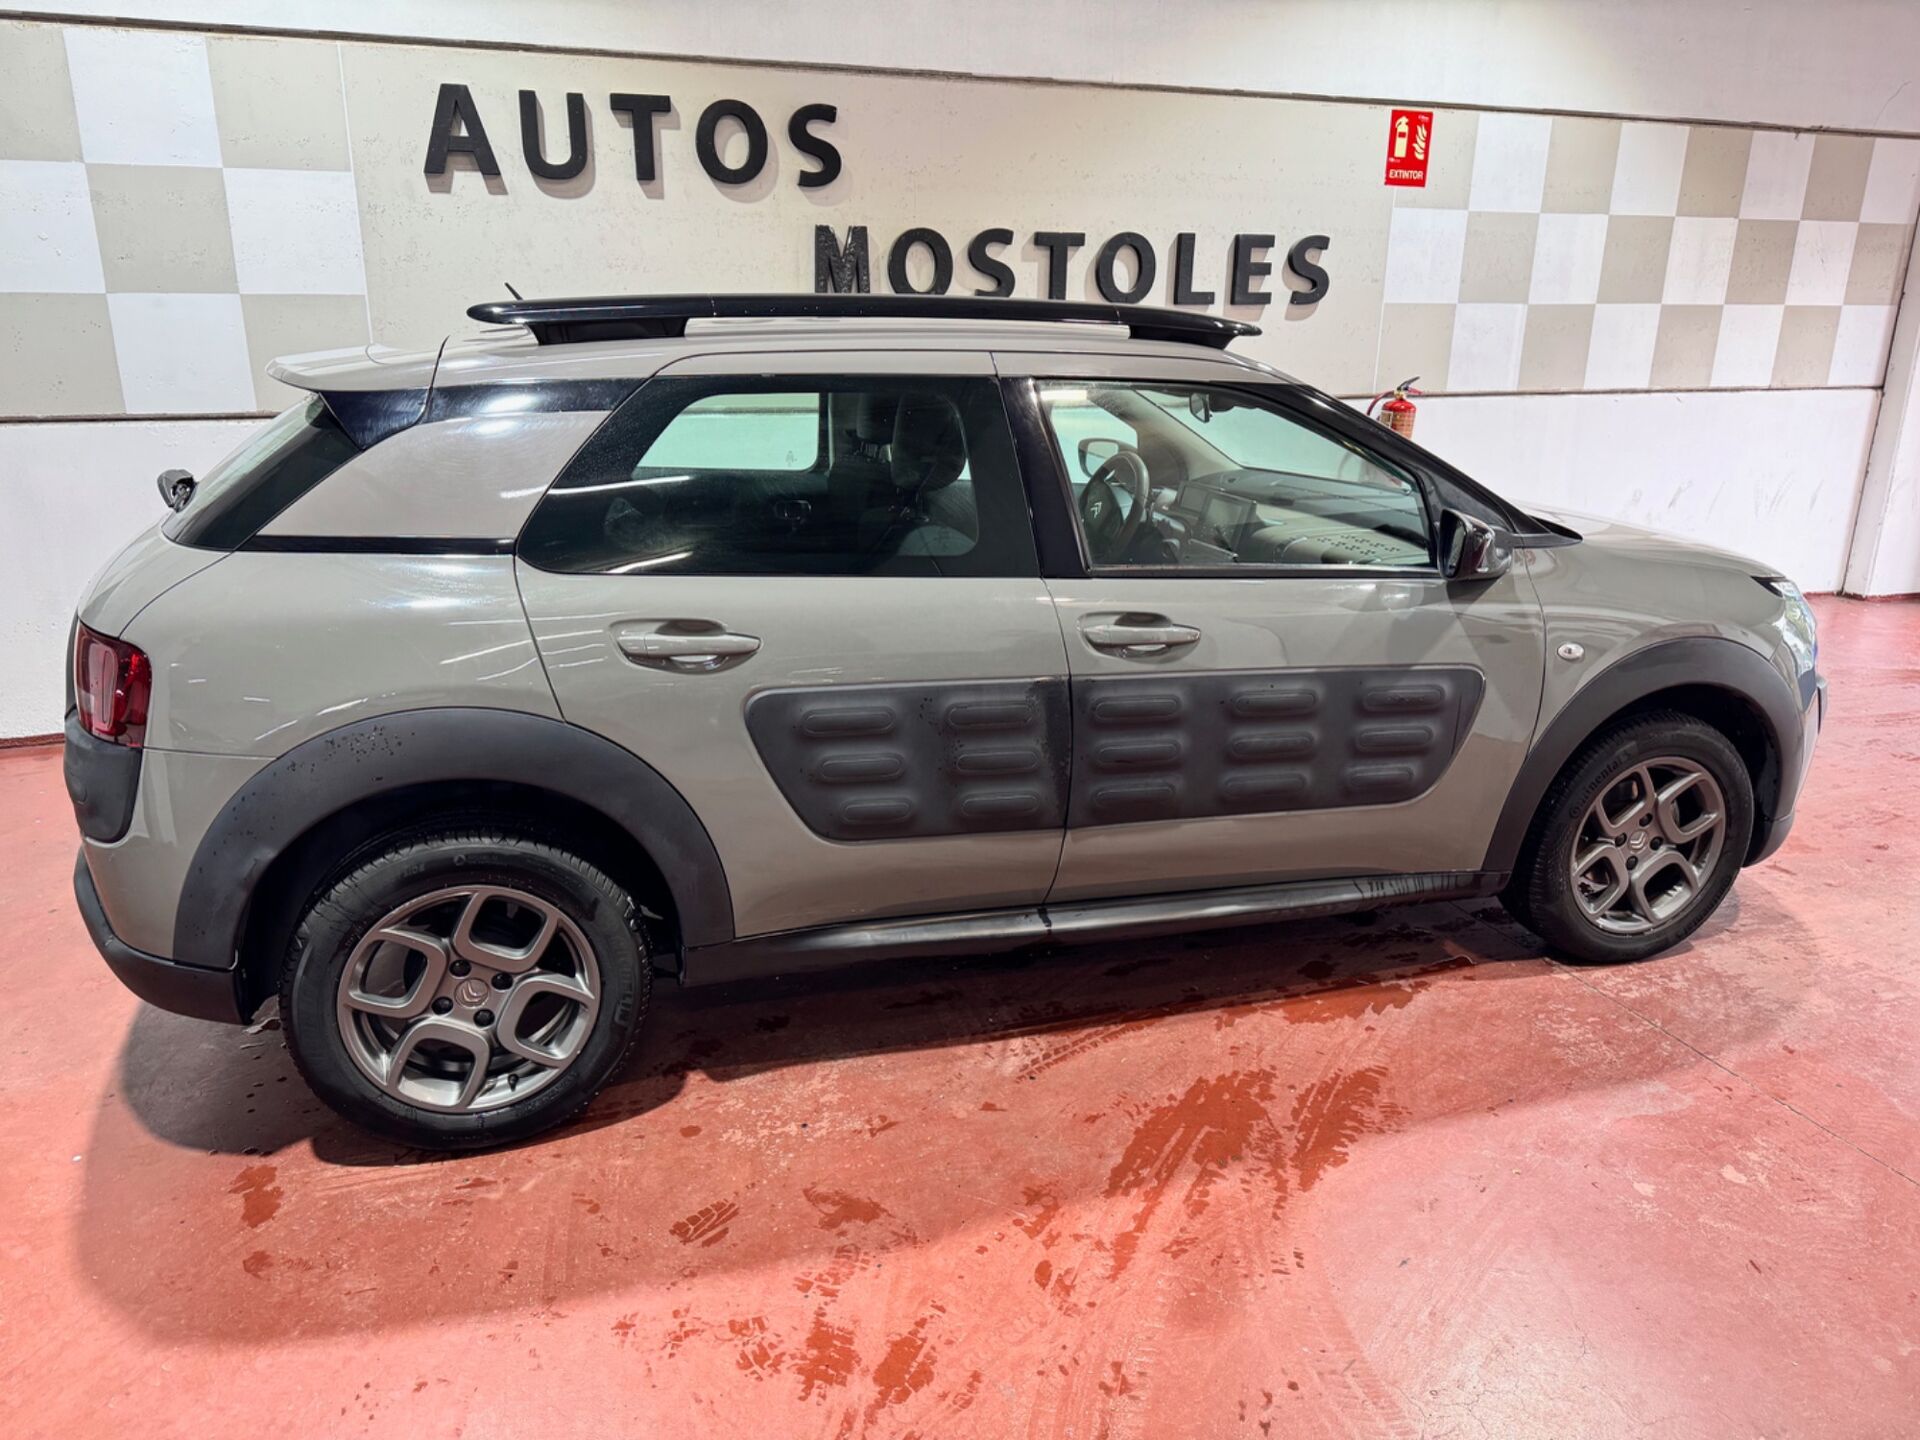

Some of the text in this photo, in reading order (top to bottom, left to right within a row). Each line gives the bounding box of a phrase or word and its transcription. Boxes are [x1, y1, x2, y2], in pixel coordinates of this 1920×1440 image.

[424, 83, 842, 187] AUTOS
[1389, 169, 1424, 180] EXTINTOR
[815, 224, 1330, 305] MOSTOLES
